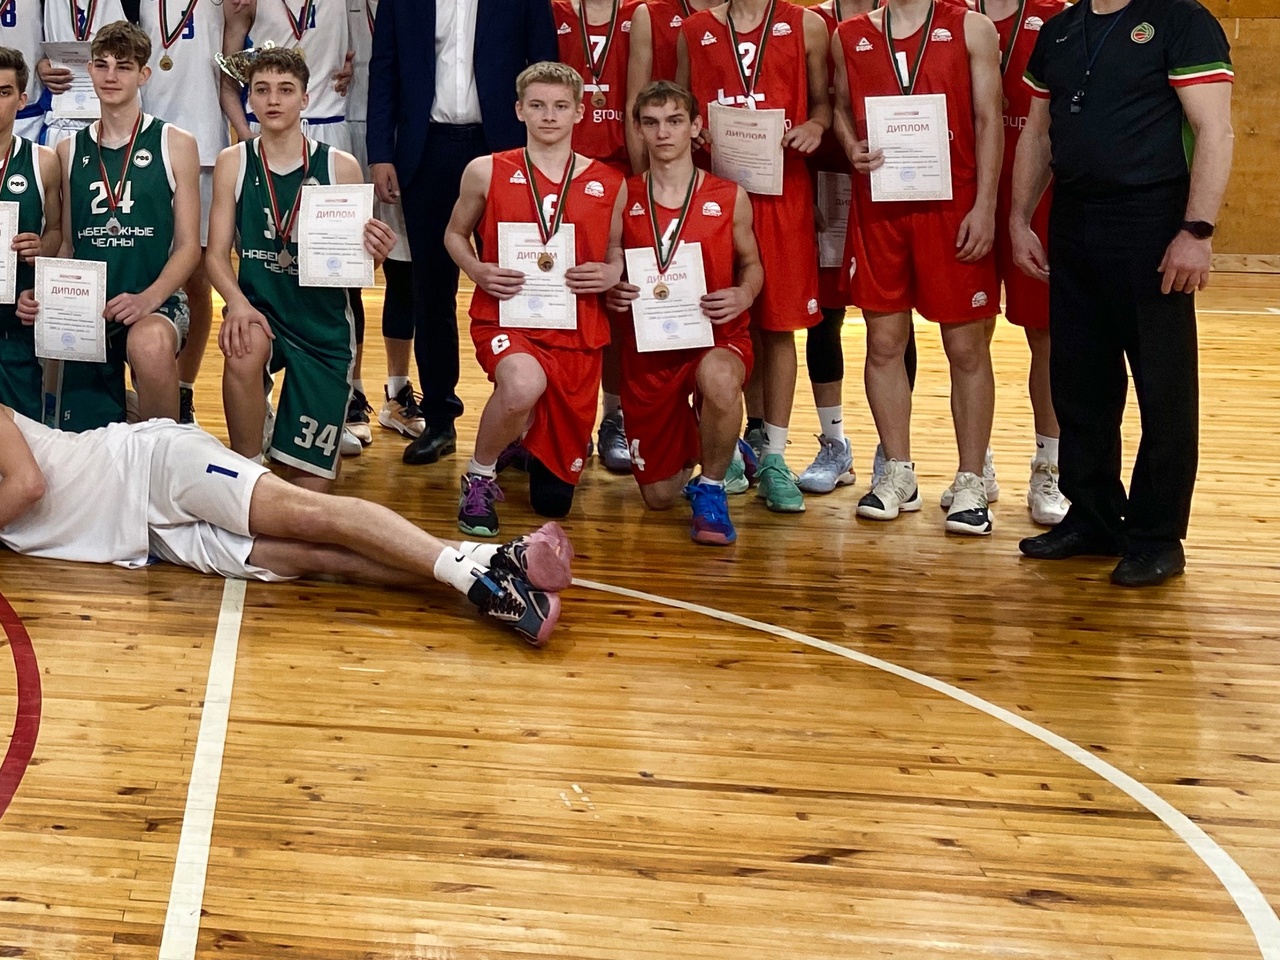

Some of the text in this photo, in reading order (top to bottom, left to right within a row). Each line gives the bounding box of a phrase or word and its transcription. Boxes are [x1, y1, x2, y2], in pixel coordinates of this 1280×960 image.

[588, 35, 607, 65] 7
[738, 42, 757, 76] 2
[894, 51, 910, 87] 1
[724, 129, 767, 140] ДИПЛОМ
[886, 123, 930, 134] ДИПЛОМ
[89, 180, 135, 215] 24
[315, 210, 356, 219] ДИПЛОМ
[91, 238, 135, 248] ЧЕЛНЫ
[517, 251, 558, 260] ДИПЛМ
[646, 272, 688, 284] ДИПЛОМ
[50, 286, 90, 297] ДИПЛОМ
[294, 415, 339, 457] 34
[206, 463, 239, 480] 1
